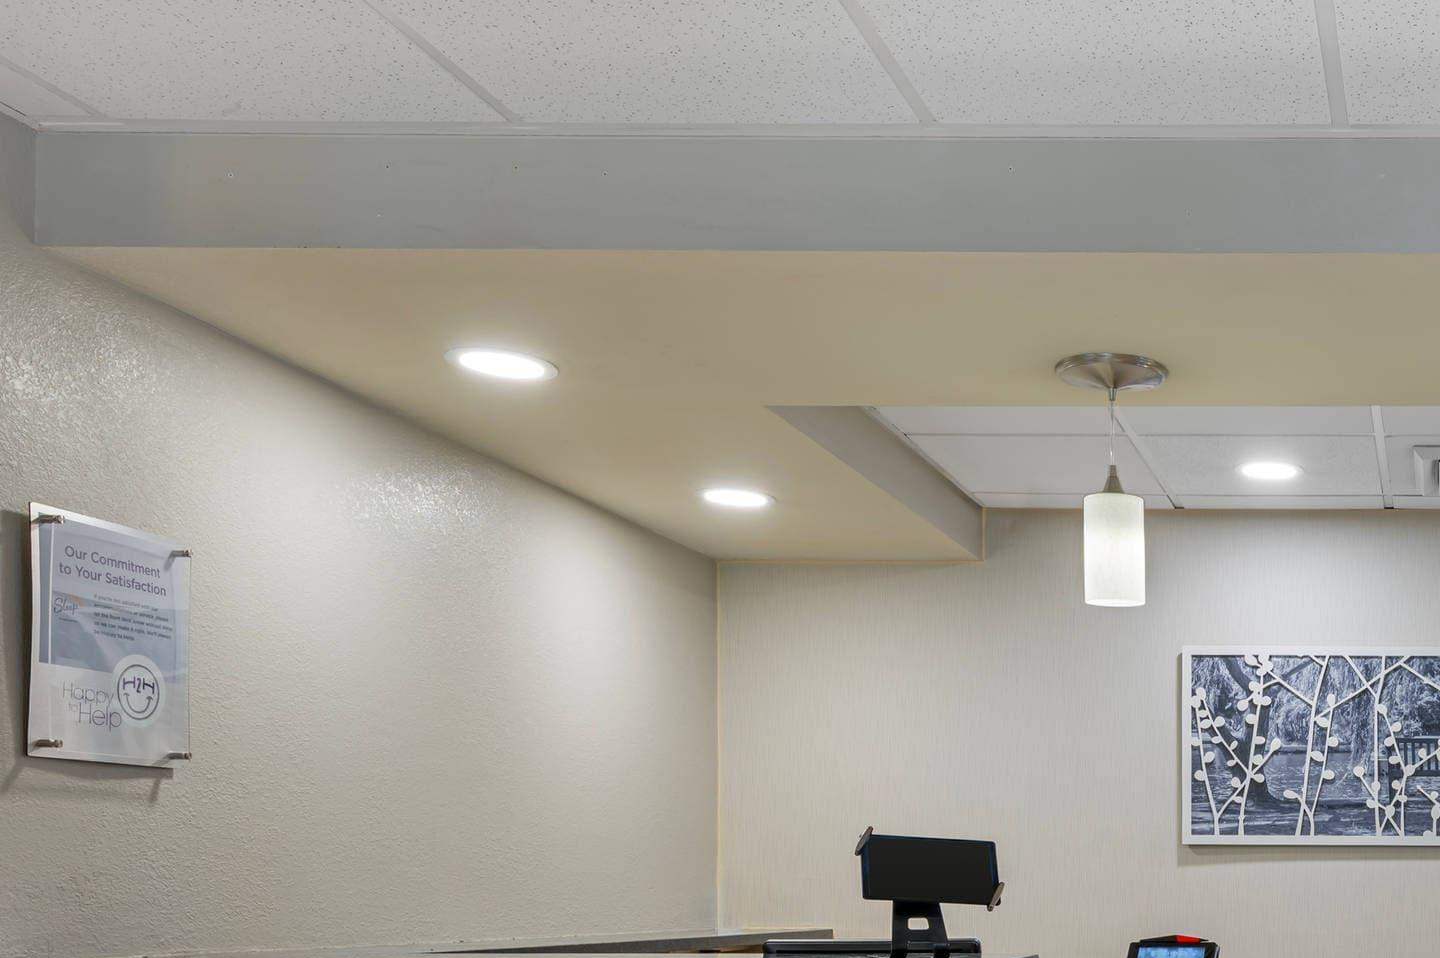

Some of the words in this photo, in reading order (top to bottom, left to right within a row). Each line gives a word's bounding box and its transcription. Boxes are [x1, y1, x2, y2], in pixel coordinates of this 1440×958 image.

[64, 545, 88, 561] Our
[91, 551, 161, 579] Commitment
[58, 562, 72, 575] to
[75, 565, 102, 582] Your
[105, 572, 167, 596] Satisfaction
[62, 681, 115, 708] Happy
[123, 676, 155, 695] H2H
[78, 702, 122, 733] Help
